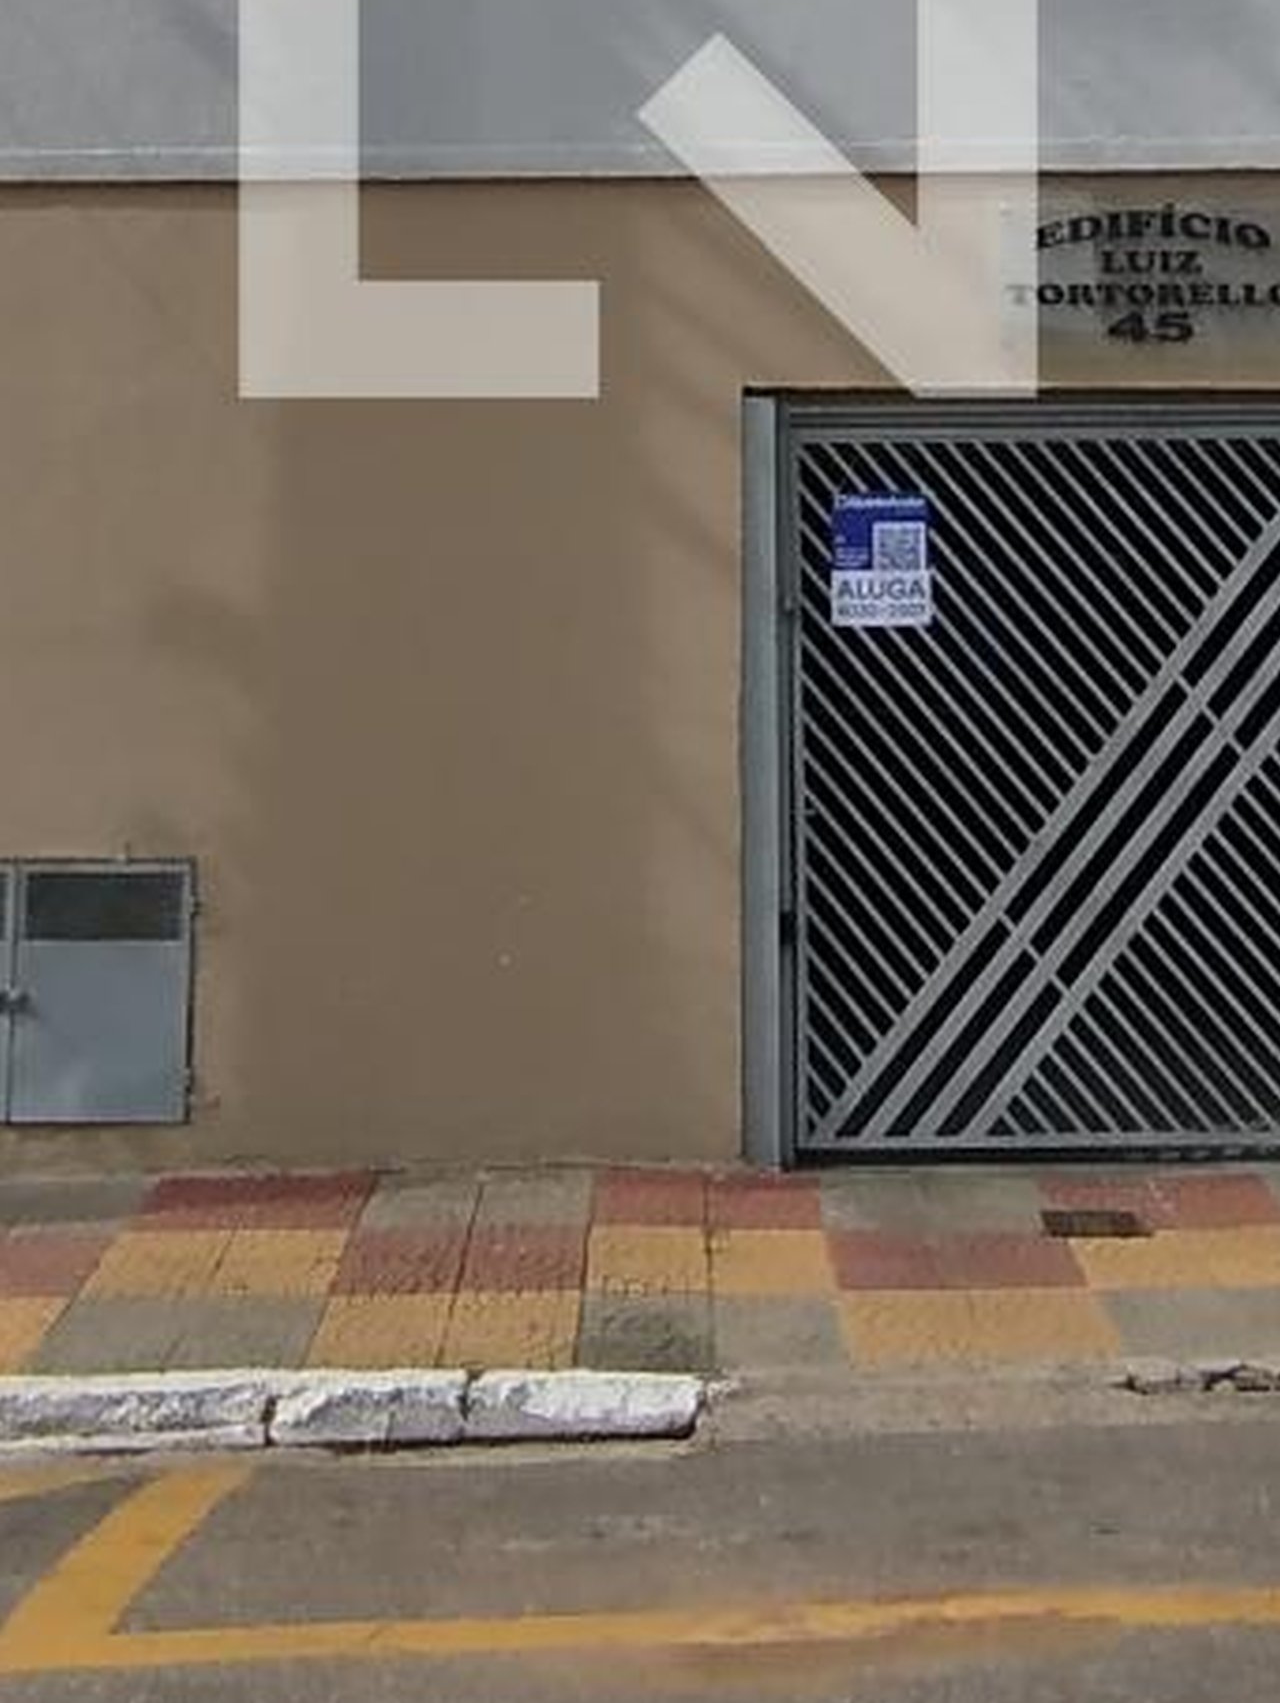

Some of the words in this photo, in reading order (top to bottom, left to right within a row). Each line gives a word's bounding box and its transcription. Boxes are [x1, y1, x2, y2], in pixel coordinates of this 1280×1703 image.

[1036, 203, 1271, 250] EDIFÍCIO
[1100, 250, 1203, 275] LUIZ
[1107, 311, 1194, 343] 45
[837, 579, 926, 599] ALUGA
